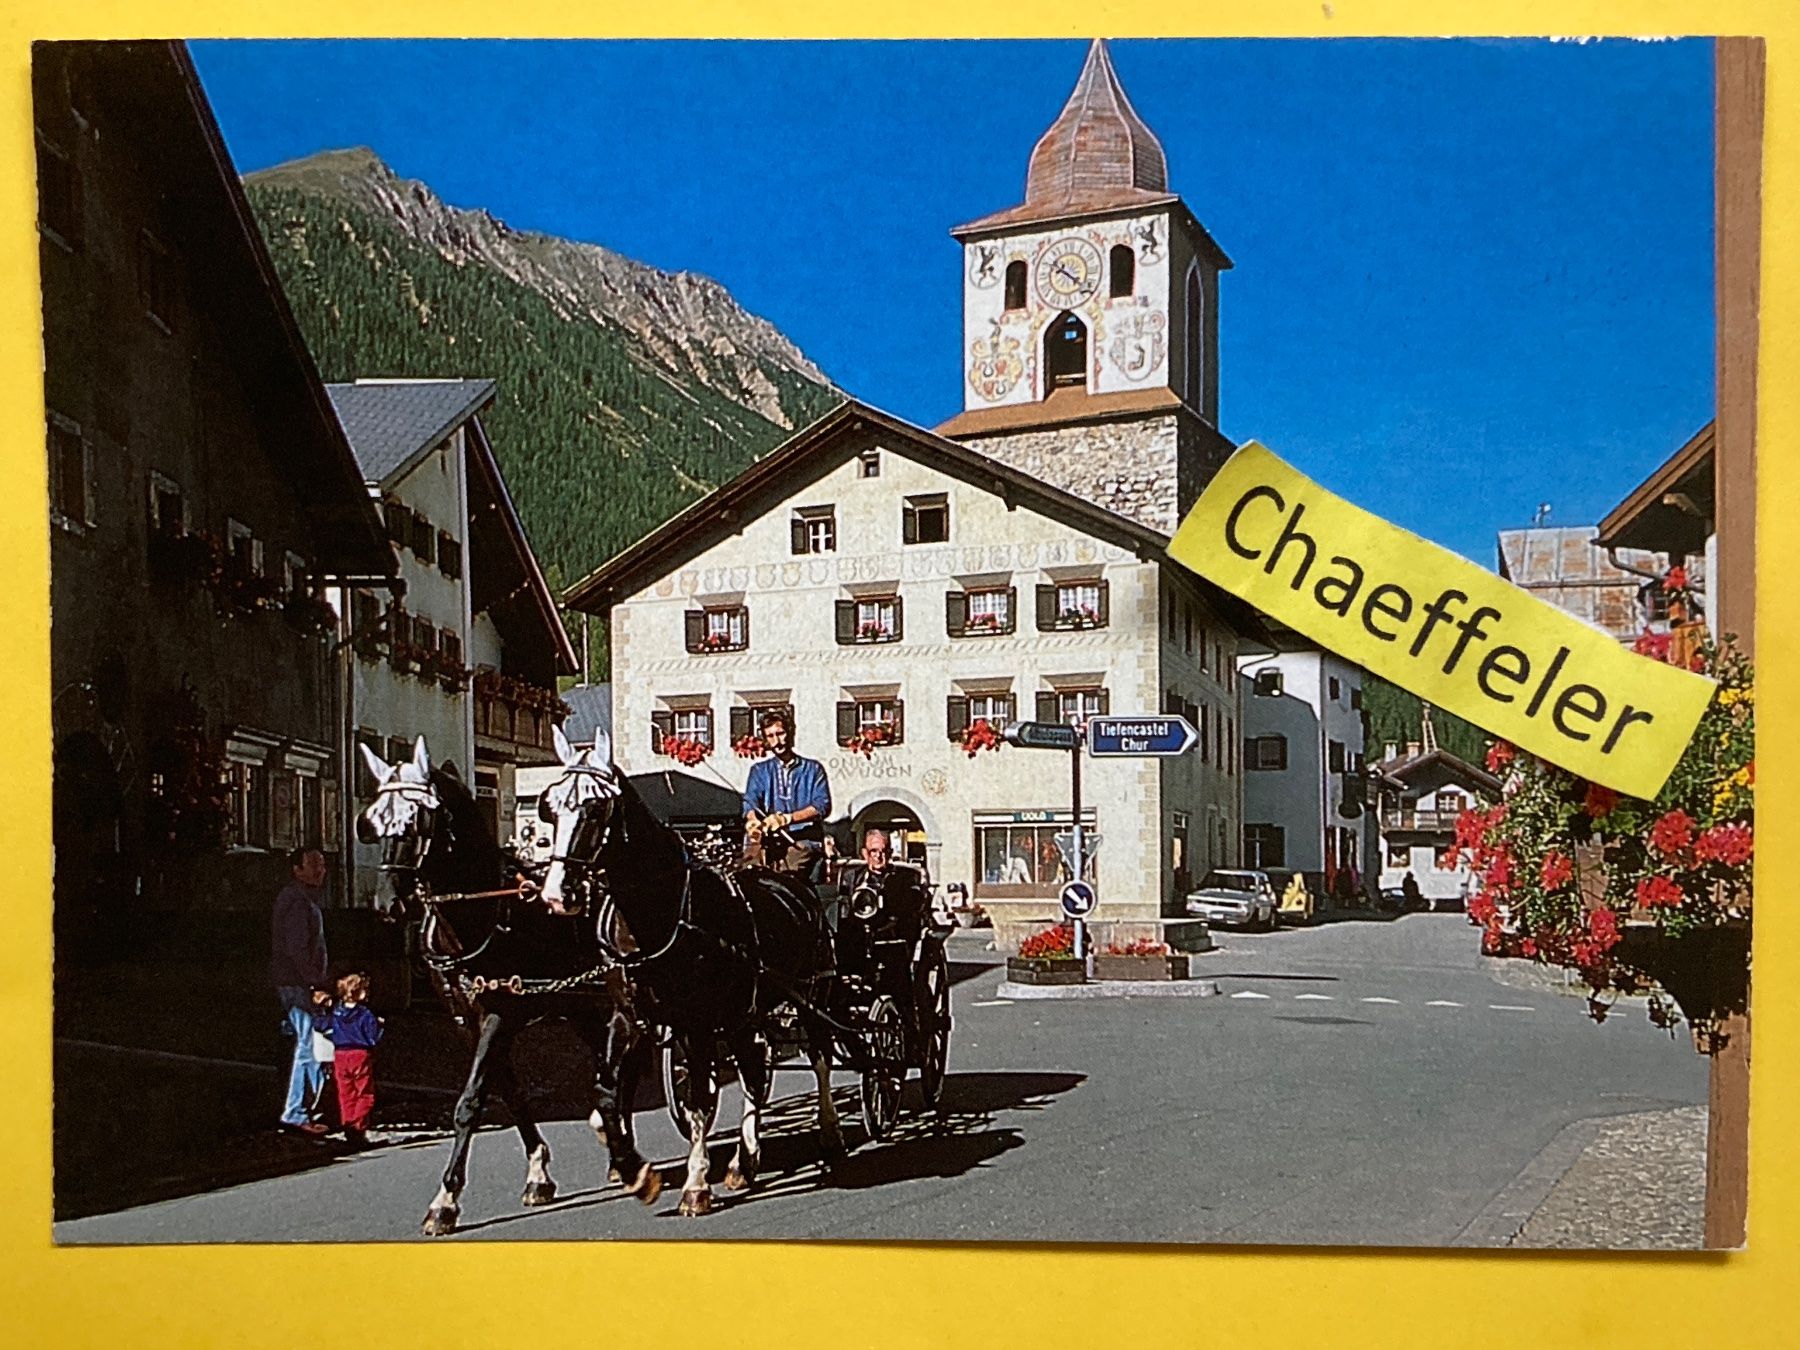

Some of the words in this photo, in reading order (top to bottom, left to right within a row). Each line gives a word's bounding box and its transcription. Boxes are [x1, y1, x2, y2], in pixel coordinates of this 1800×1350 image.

[1225, 485, 1654, 754] Chaeffeler
[1100, 722, 1169, 737] Tiefencastel
[1121, 738, 1149, 751] Chur
